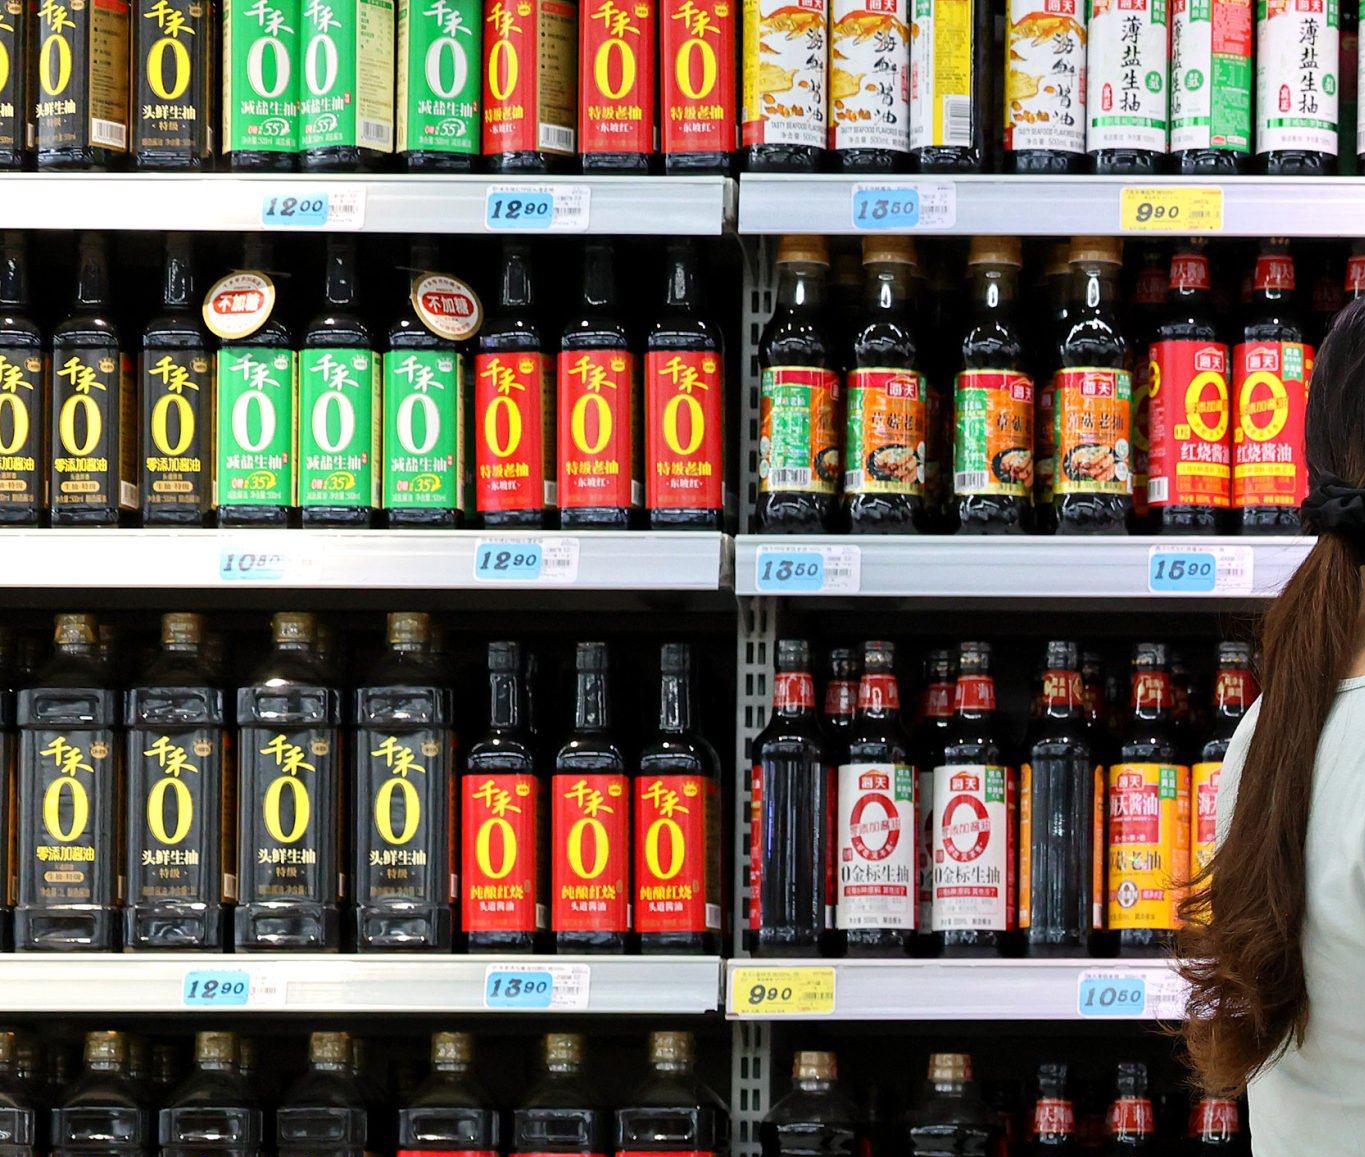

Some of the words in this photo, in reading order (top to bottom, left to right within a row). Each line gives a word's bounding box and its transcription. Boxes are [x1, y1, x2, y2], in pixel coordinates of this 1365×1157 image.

[217, 291, 260, 314] 不加糖
[60, 394, 102, 456] 0
